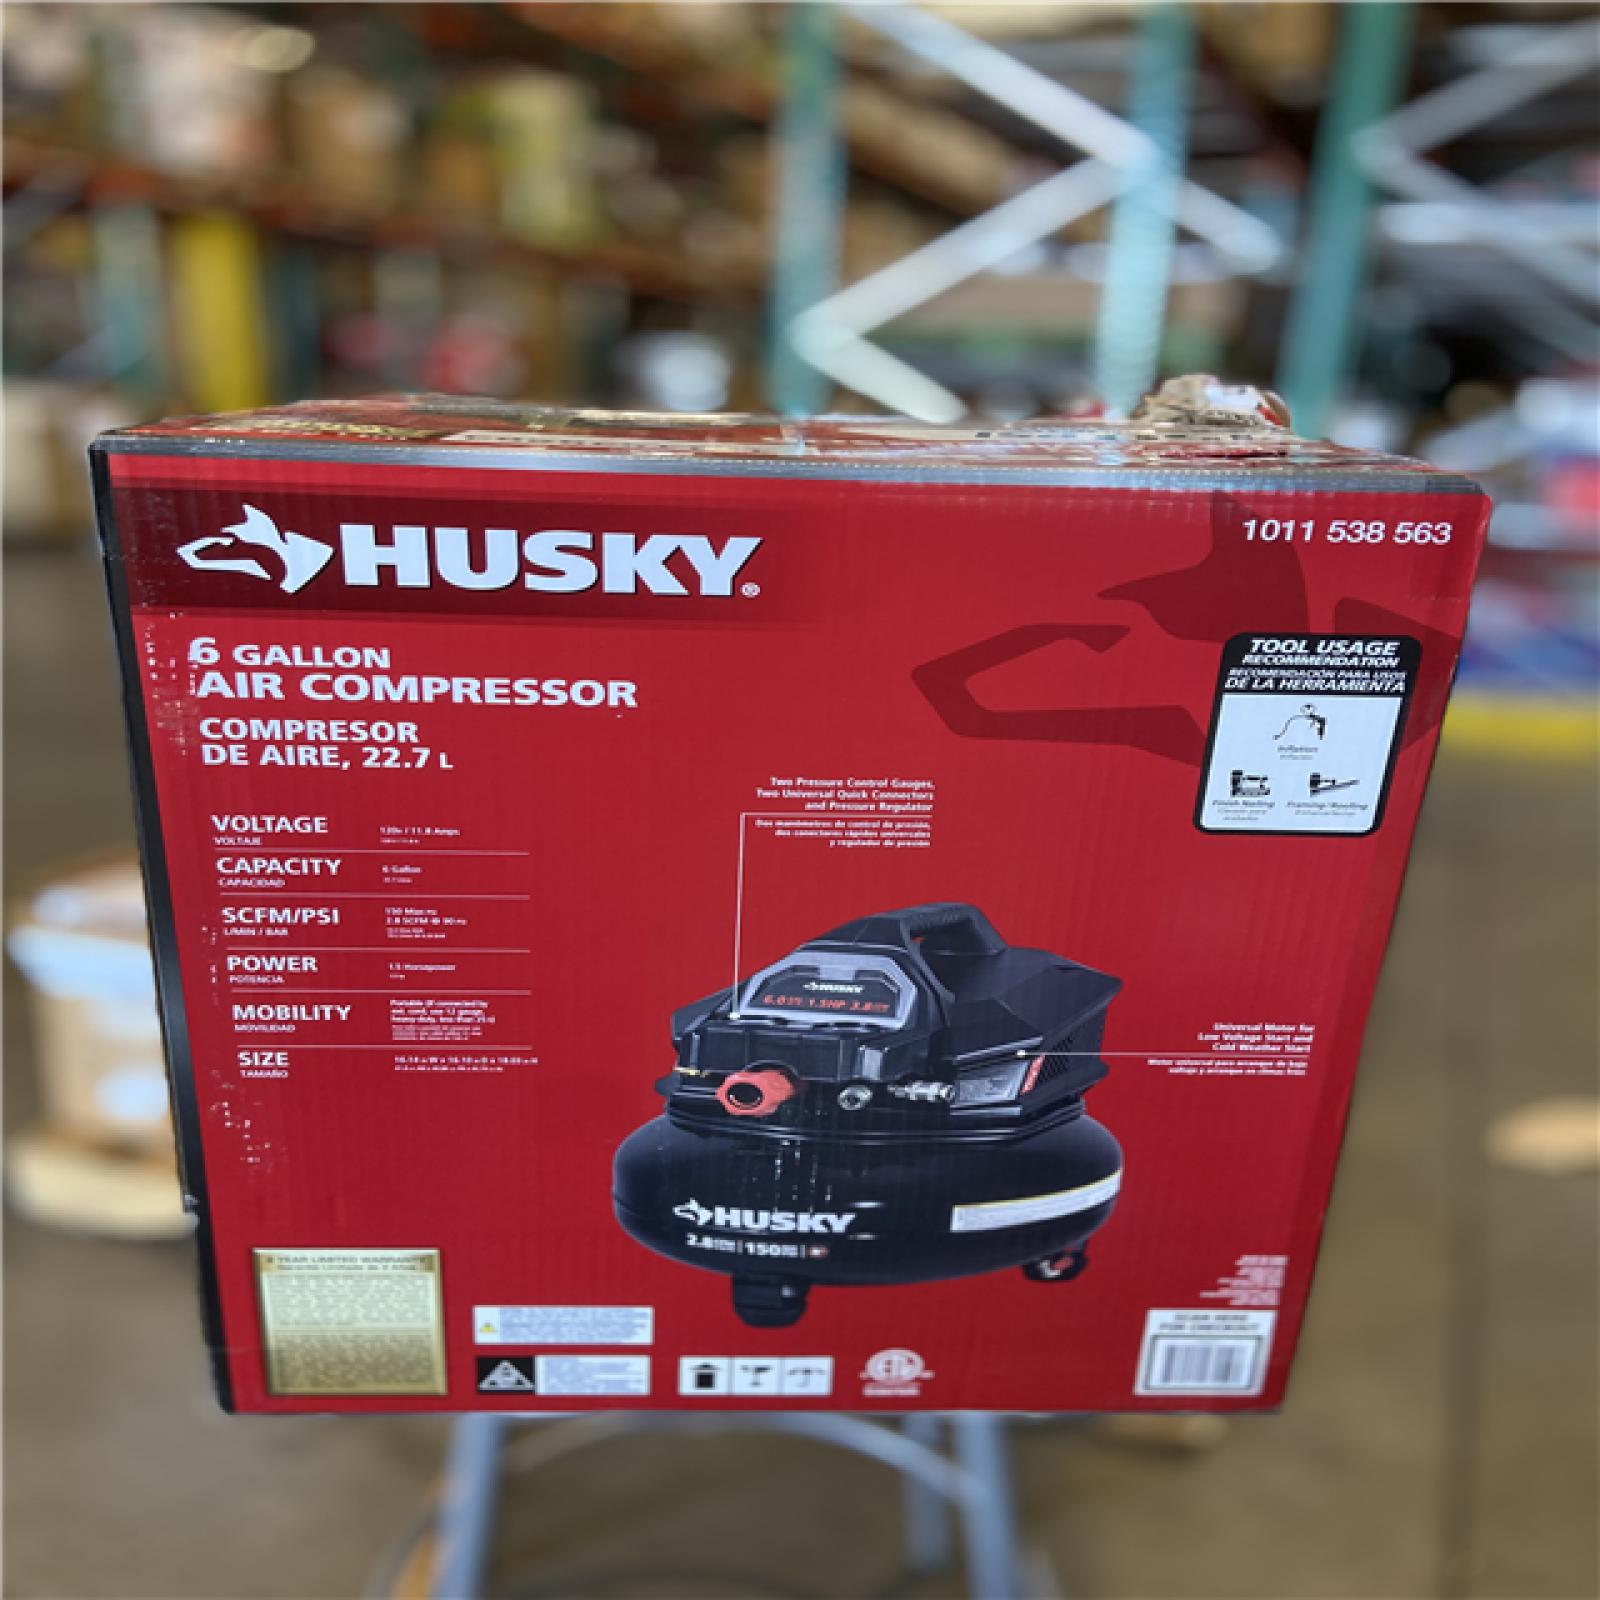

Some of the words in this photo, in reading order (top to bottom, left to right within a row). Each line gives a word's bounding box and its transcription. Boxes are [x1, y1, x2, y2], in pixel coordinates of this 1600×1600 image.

[1243, 519, 1314, 542] 1011
[1327, 521, 1385, 543] 538
[1393, 521, 1452, 545] 563
[191, 636, 219, 666] 6
[233, 645, 391, 669] GALLON
[1250, 639, 1308, 654] TOOL
[1316, 639, 1400, 656] USAGE
[1241, 654, 1400, 668] RECOMMENDATION
[196, 672, 284, 701] AIR
[300, 674, 638, 708] COMPRESSOR
[1224, 677, 1250, 690] DE
[1253, 678, 1275, 690] LA
[1279, 677, 1405, 693] HERRAMIENTA
[200, 717, 419, 743] COMPRESOR
[202, 744, 251, 767] DE
[260, 745, 351, 771] AIRE,
[362, 747, 430, 768] 22.7
[441, 752, 454, 769] L
[770, 777, 793, 787] Two
[796, 776, 843, 787] Pressure
[847, 777, 888, 787] Control
[756, 787, 780, 798] Two
[782, 788, 835, 799] Universal
[837, 790, 868, 800] Quick
[872, 789, 933, 800] Connectors
[804, 801, 825, 811] and
[829, 801, 875, 811] Pressure
[878, 801, 933, 813] Regulator
[211, 814, 329, 834] VOLTAGE
[213, 836, 262, 847] VOLTAJE
[216, 857, 342, 876] CAPACITY
[217, 877, 286, 888] CAPACIDAD
[221, 907, 341, 925] SCFM/PSI
[265, 927, 289, 937] BAR
[227, 955, 319, 973] POWER
[229, 975, 285, 984] POTENCIA
[232, 1004, 352, 1022] MOBILITY
[234, 1024, 295, 1033] MOVILIDAD
[1214, 1022, 1263, 1031] Universal
[1264, 1022, 1298, 1031] Motor
[1222, 1033, 1263, 1043] Voltage
[1264, 1033, 1291, 1043] Start
[238, 1052, 290, 1067] SIZE
[240, 1069, 289, 1079] TAMAÑO
[714, 1204, 856, 1233] HUSKY
